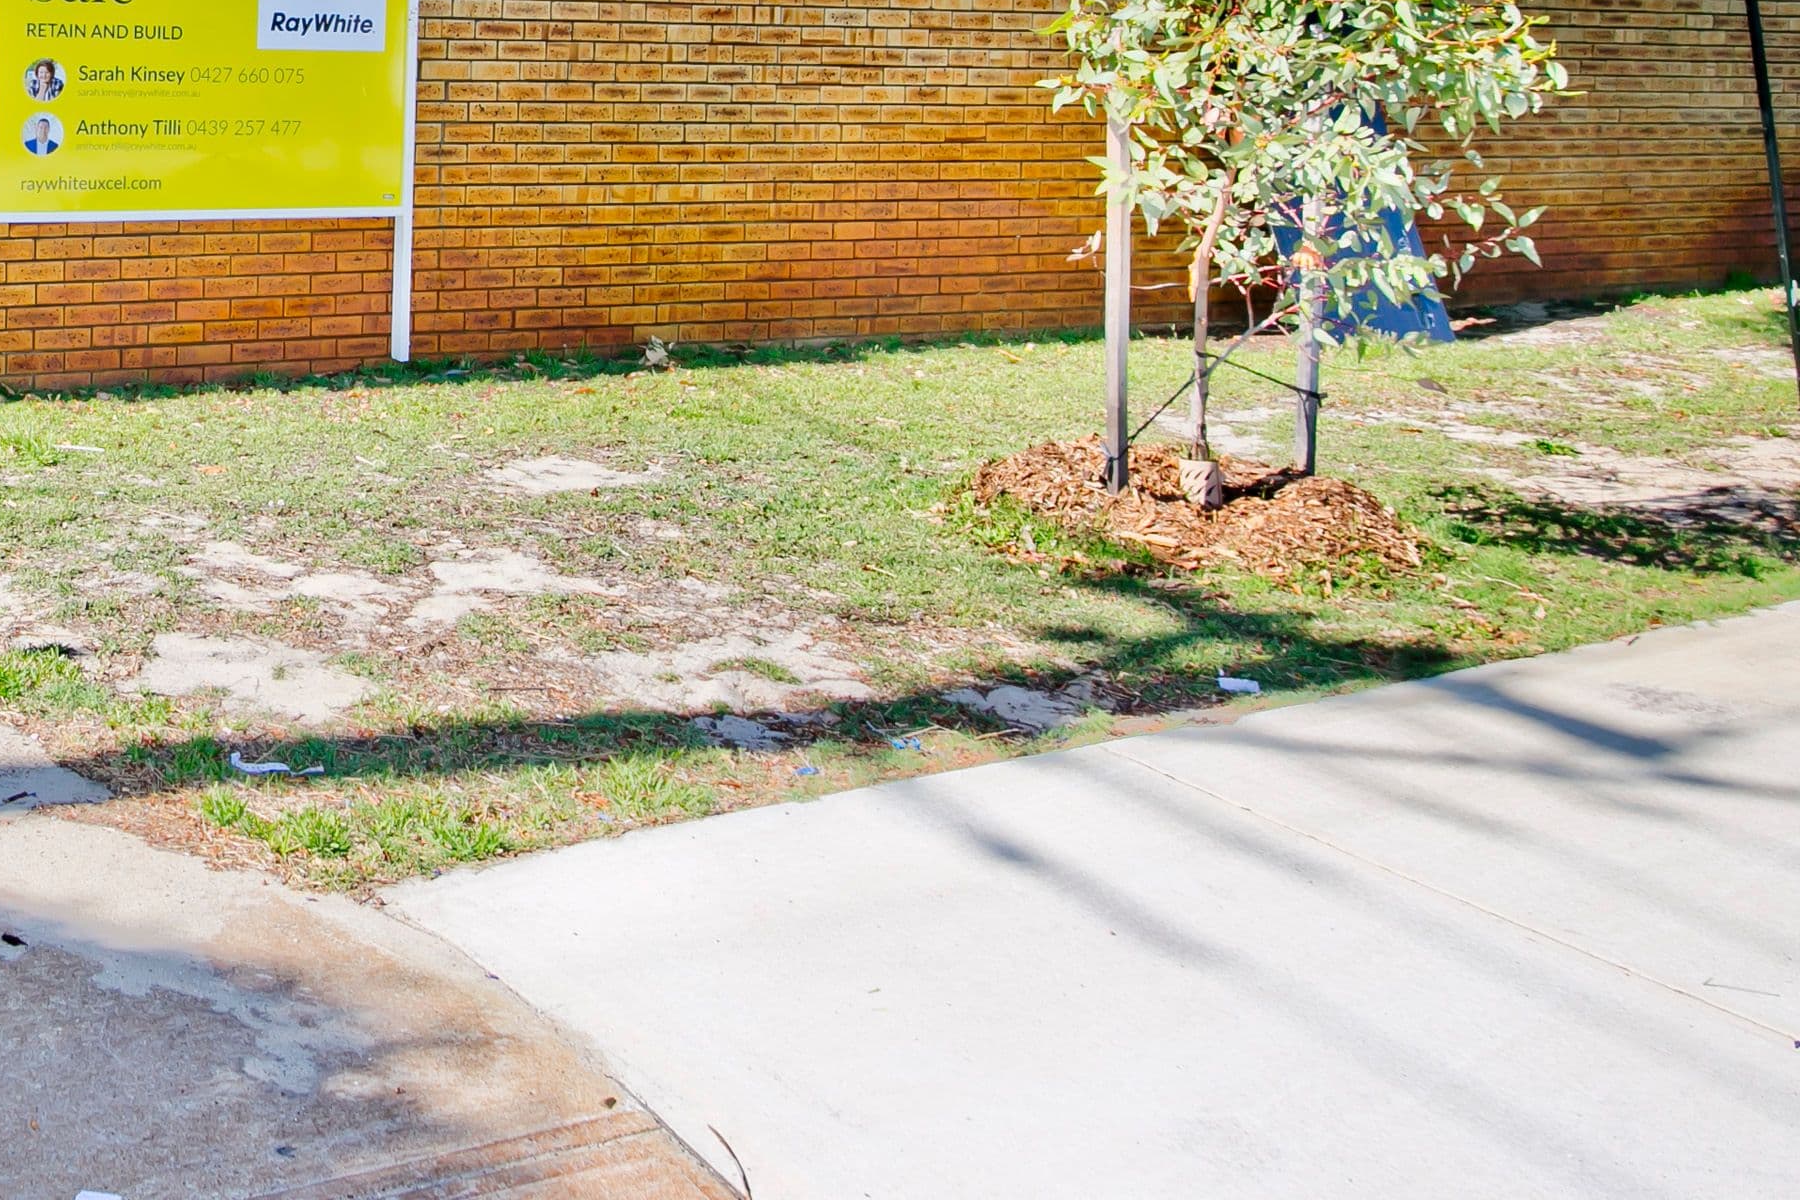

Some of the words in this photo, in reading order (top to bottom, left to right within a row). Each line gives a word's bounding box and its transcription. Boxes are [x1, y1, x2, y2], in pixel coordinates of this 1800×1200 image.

[26, 23, 86, 39] RETAIN
[91, 24, 129, 39] AND
[134, 25, 183, 41] BUILD
[78, 65, 125, 82] Sarah
[131, 66, 185, 85] Kinsey
[190, 67, 233, 84] 0427
[238, 67, 269, 84] 660
[274, 68, 305, 85] 075
[76, 119, 148, 138] Anthony
[153, 119, 182, 136] Tilli
[186, 119, 229, 136] 0439
[234, 120, 265, 137] 257
[270, 120, 302, 137] 477
[20, 175, 162, 193] raywhiteuxcel.com
